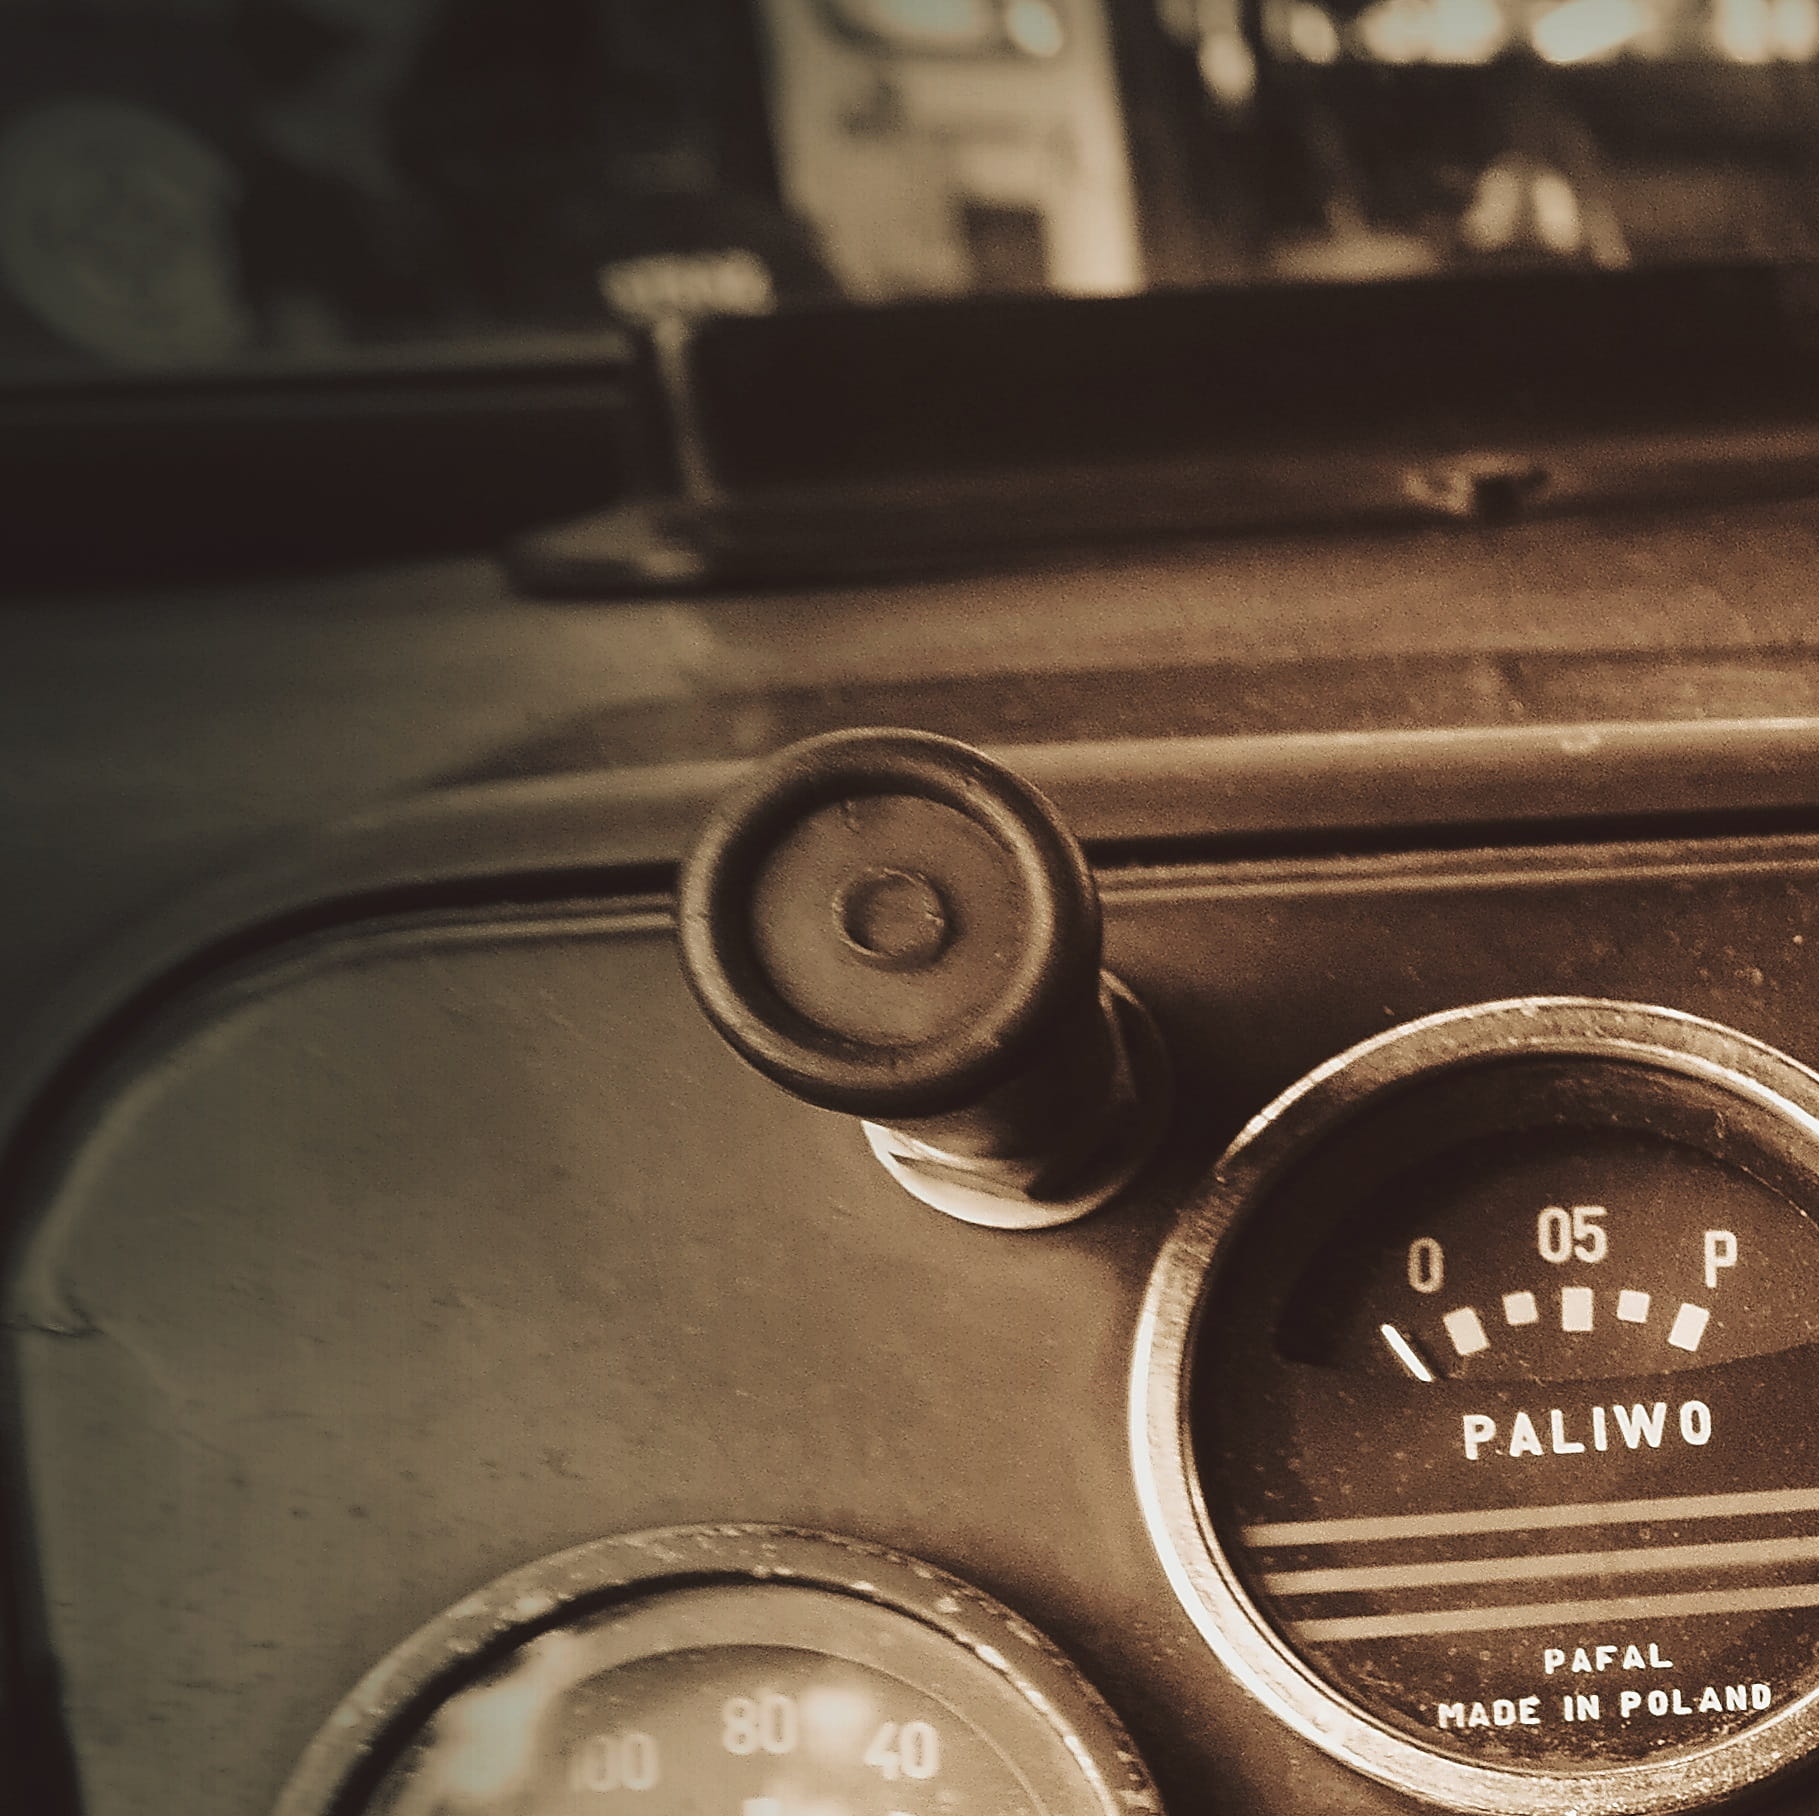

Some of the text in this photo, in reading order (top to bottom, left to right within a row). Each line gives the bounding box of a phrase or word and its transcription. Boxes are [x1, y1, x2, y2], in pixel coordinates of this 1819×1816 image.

[1537, 1206, 1608, 1264] 05
[1703, 1229, 1738, 1289] P
[1408, 1237, 1445, 1293] 0
[1462, 1399, 1712, 1461] PALIWO
[1543, 1642, 1673, 1675] PAFAL
[722, 1693, 798, 1756] 80
[1437, 1682, 1774, 1729] MADE IN POLAND
[864, 1720, 940, 1781] 40
